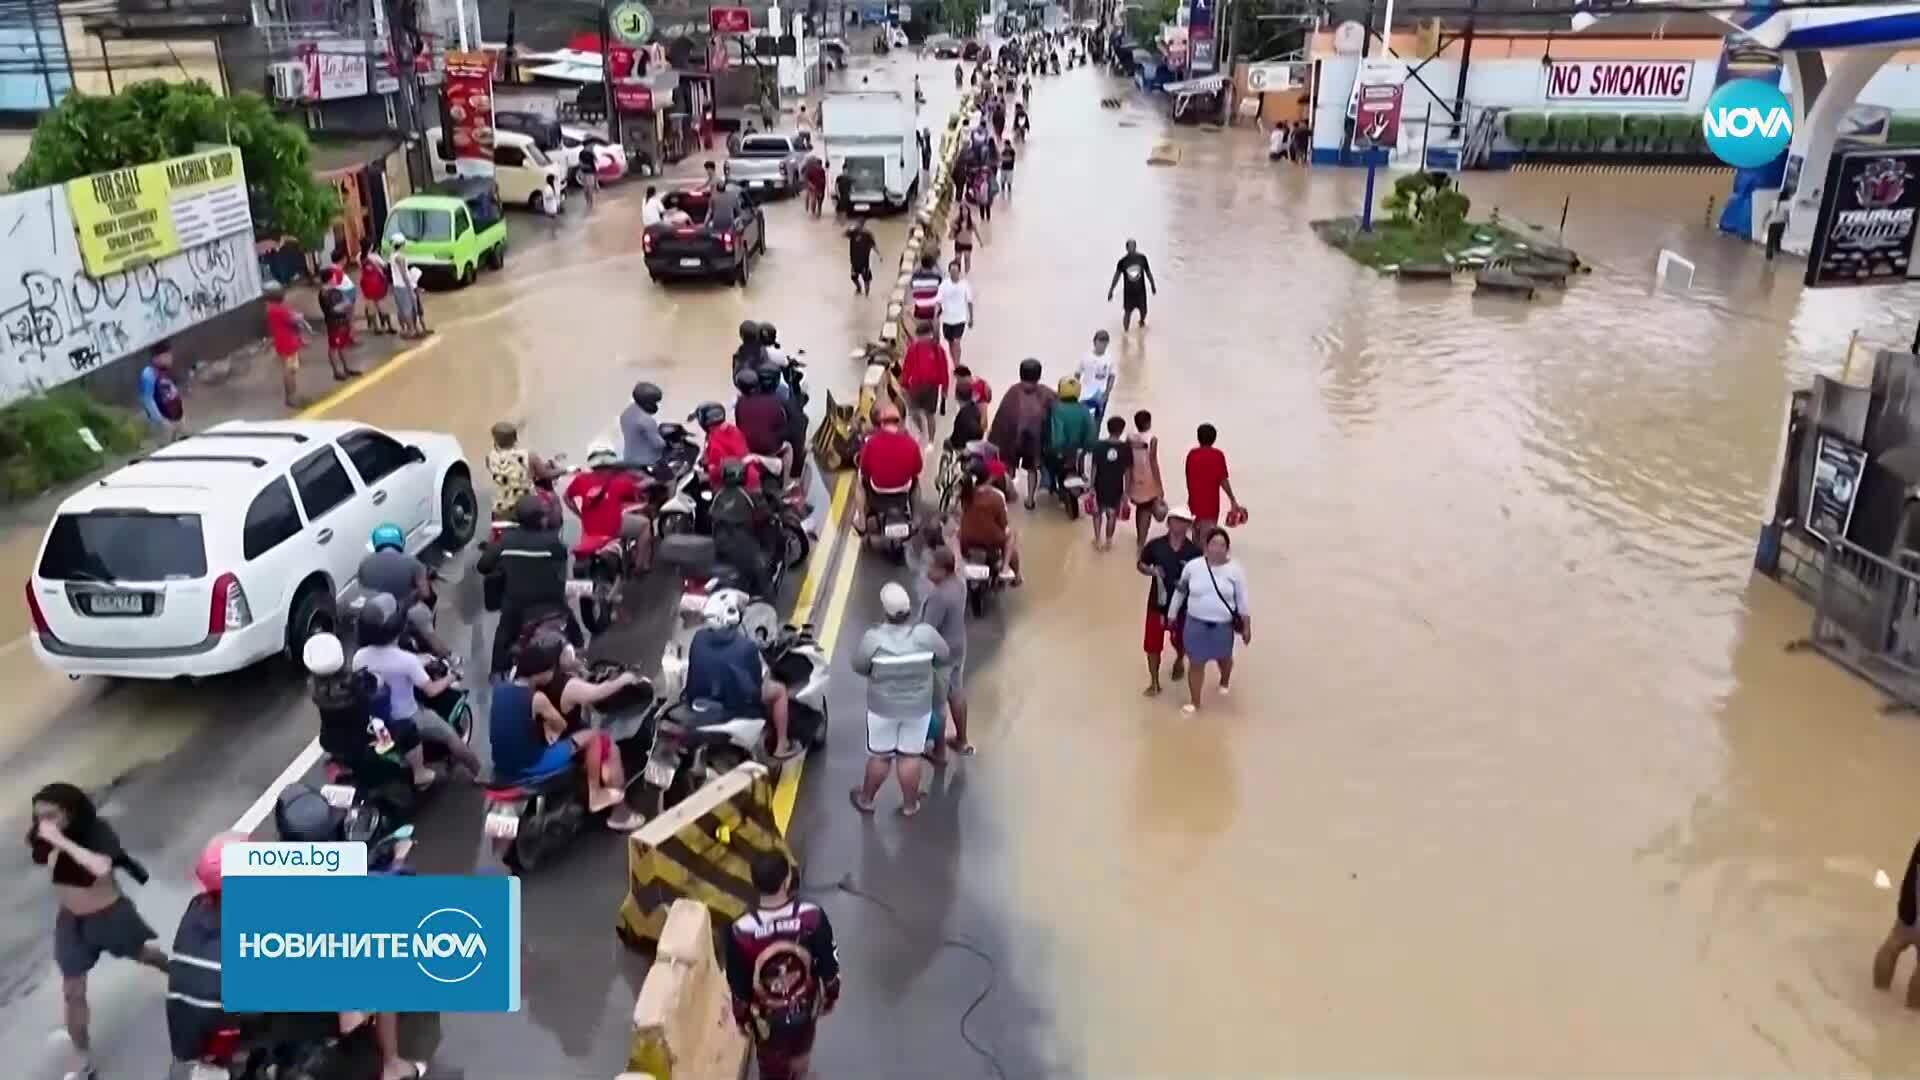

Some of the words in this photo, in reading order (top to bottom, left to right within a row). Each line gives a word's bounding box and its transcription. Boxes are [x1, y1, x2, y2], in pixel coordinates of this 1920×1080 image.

[1552, 65, 1581, 96] NO
[1589, 65, 1686, 97] SMOKING
[92, 174, 116, 203] FOR
[114, 168, 142, 199] SALE
[166, 157, 210, 187] MACHINE
[209, 152, 234, 180] SHOP
[1838, 208, 1915, 223] TAURUS
